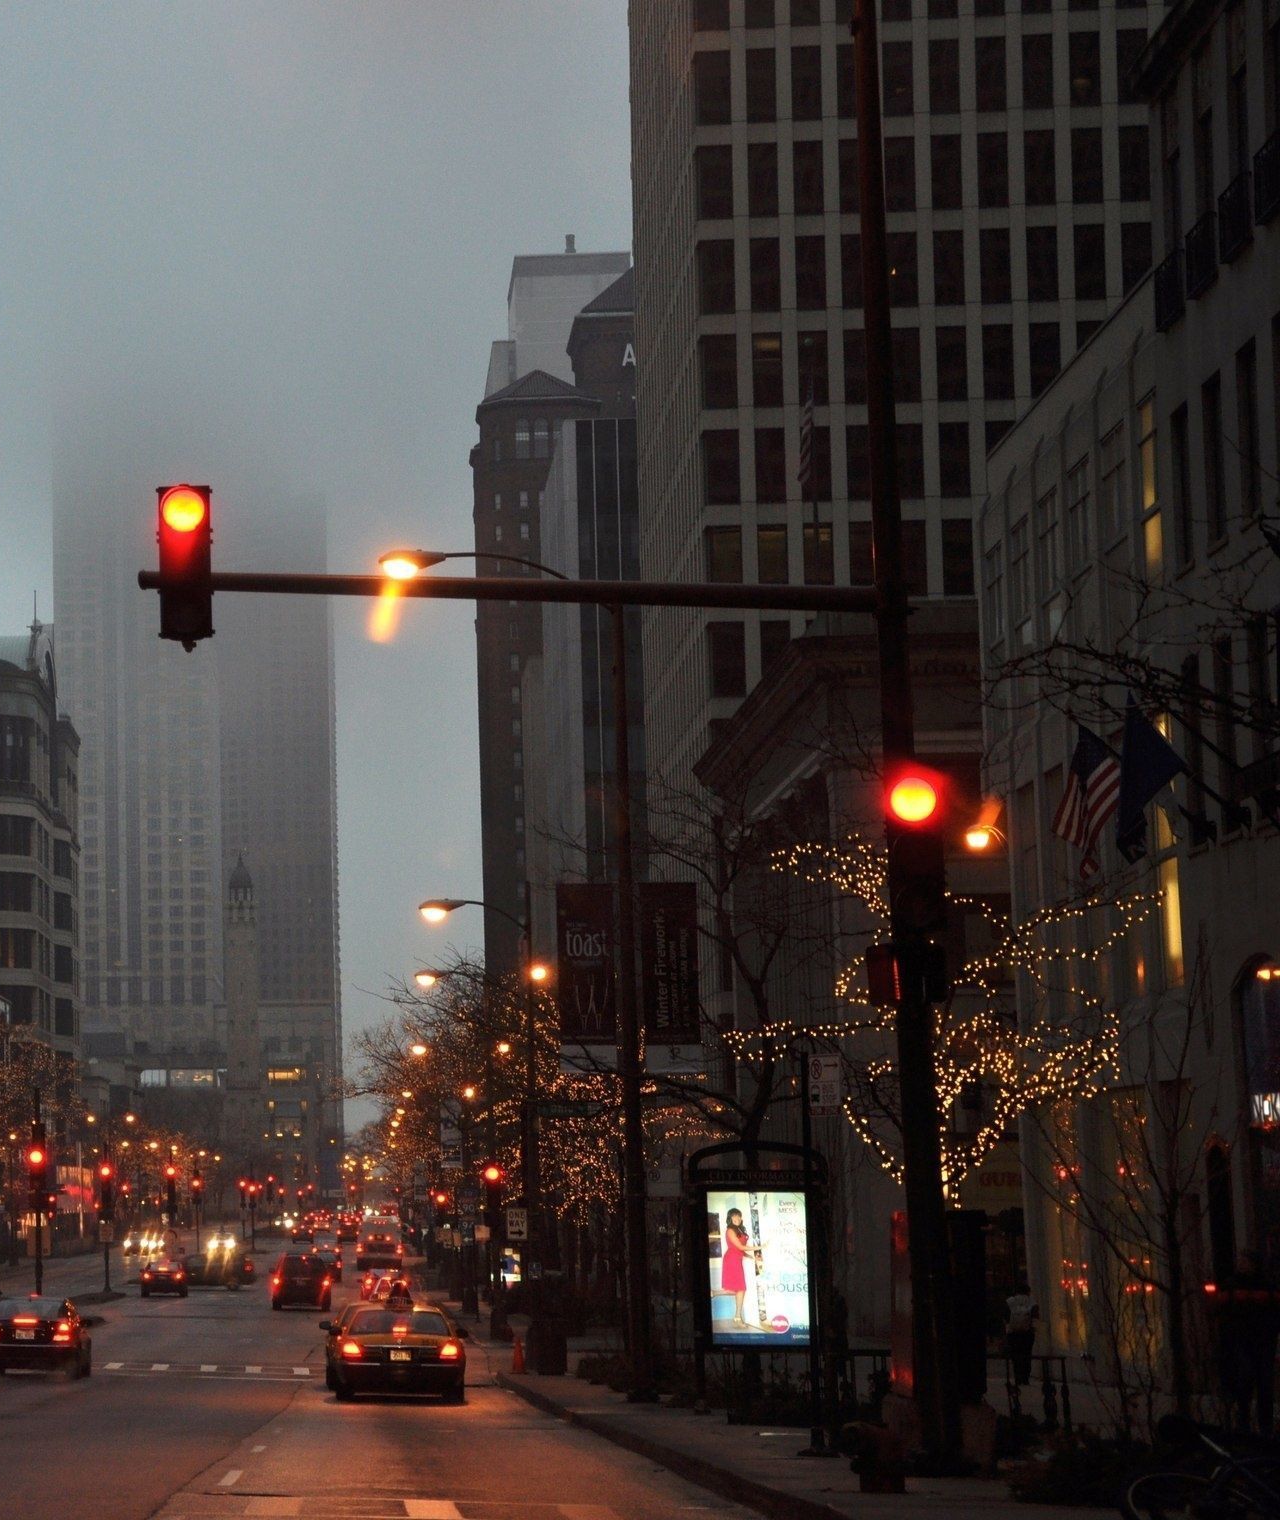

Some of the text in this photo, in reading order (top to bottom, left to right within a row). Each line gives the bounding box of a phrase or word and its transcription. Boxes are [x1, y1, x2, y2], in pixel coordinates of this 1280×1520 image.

[565, 929, 609, 958] toast
[655, 980, 670, 1029] Winter
[508, 1210, 526, 1219] ONE
[508, 1219, 526, 1228] WAY
